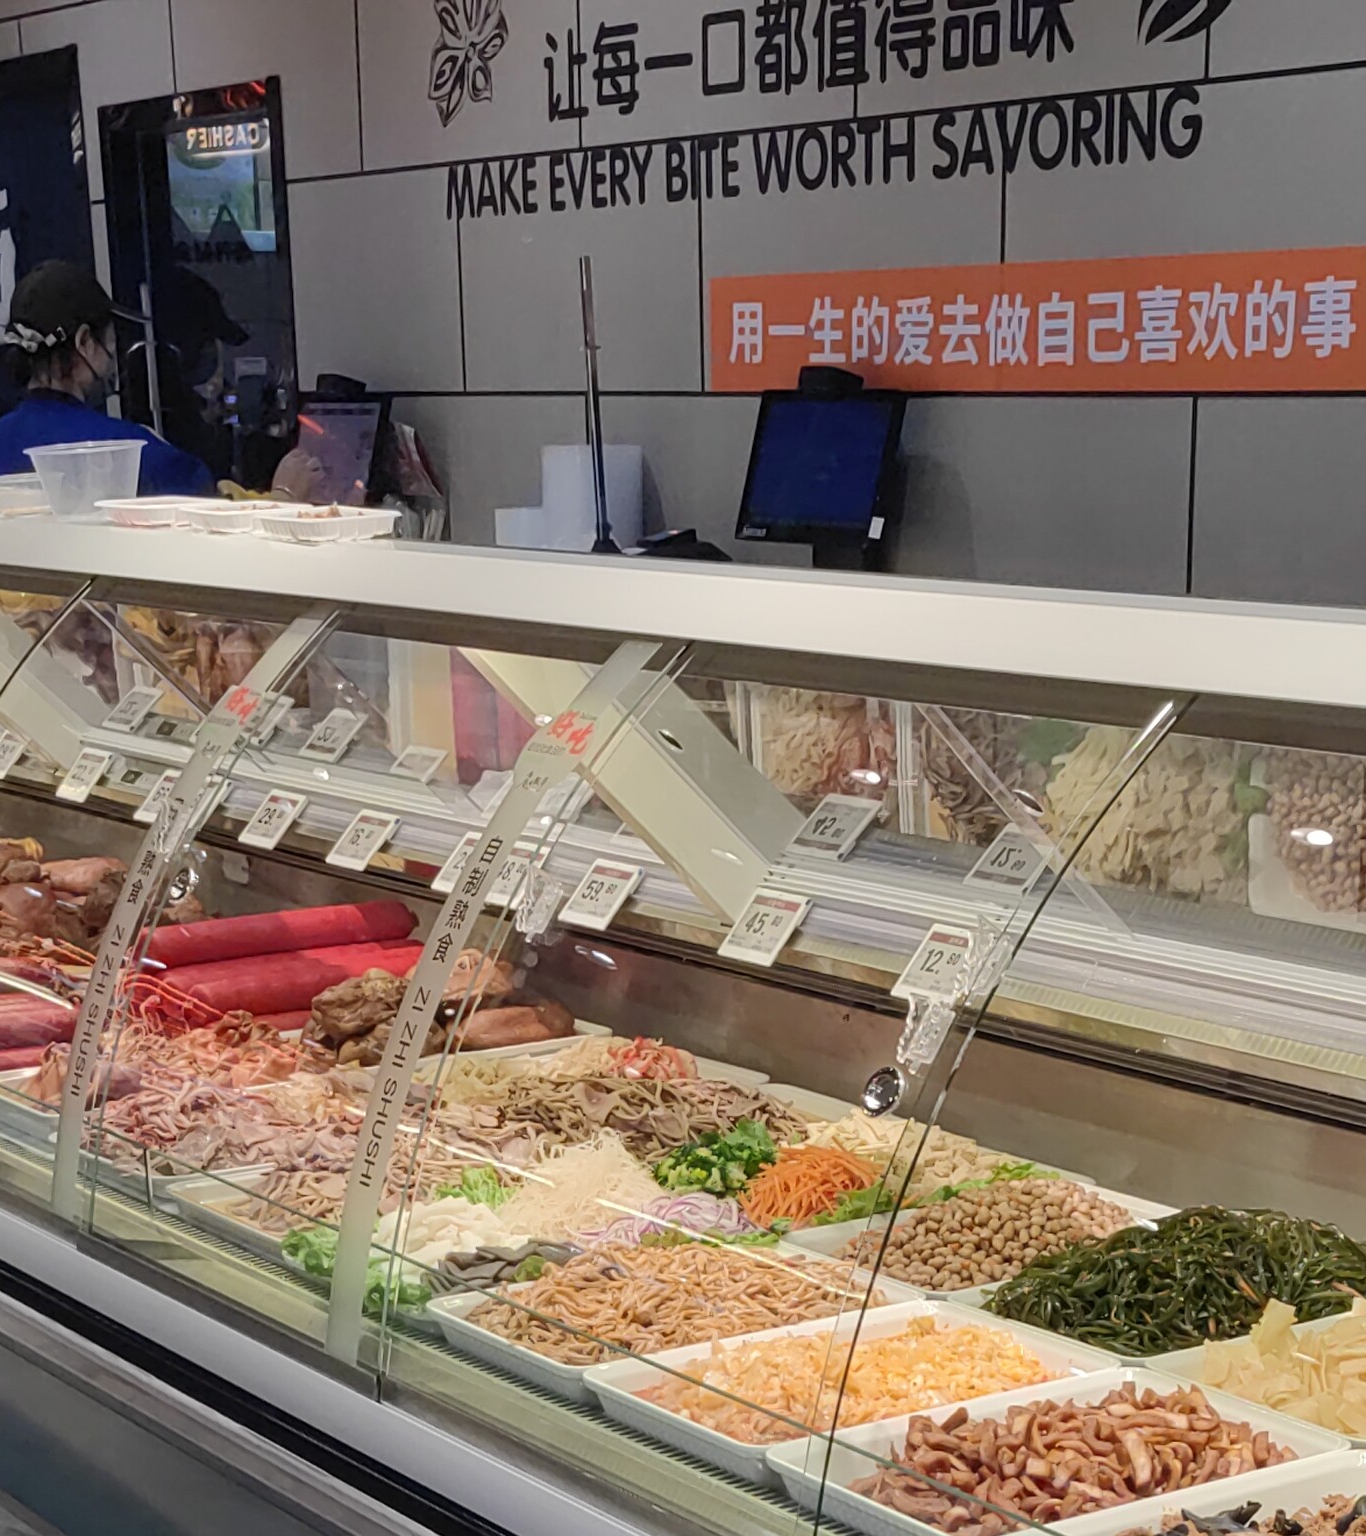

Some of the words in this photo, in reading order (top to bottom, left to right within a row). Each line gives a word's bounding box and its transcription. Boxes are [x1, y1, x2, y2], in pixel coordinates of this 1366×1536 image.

[543, 0, 1075, 122] 让每一口都值得品味
[446, 158, 538, 221] MAKE
[549, 144, 653, 212] EVERY
[665, 136, 740, 203] BITE
[753, 115, 916, 194] WORTH
[932, 86, 1203, 180] SAVORING
[729, 275, 1359, 367] 用一生的爱去做自己喜欢的事
[110, 924, 125, 947] ZI
[433, 834, 504, 964] 自制熟食
[95, 953, 114, 995] ZHI
[411, 985, 432, 1012] ZI
[70, 1002, 99, 1097] SHUSHI
[391, 1021, 418, 1068] ZHI
[358, 1077, 398, 1187] SHUSHI
